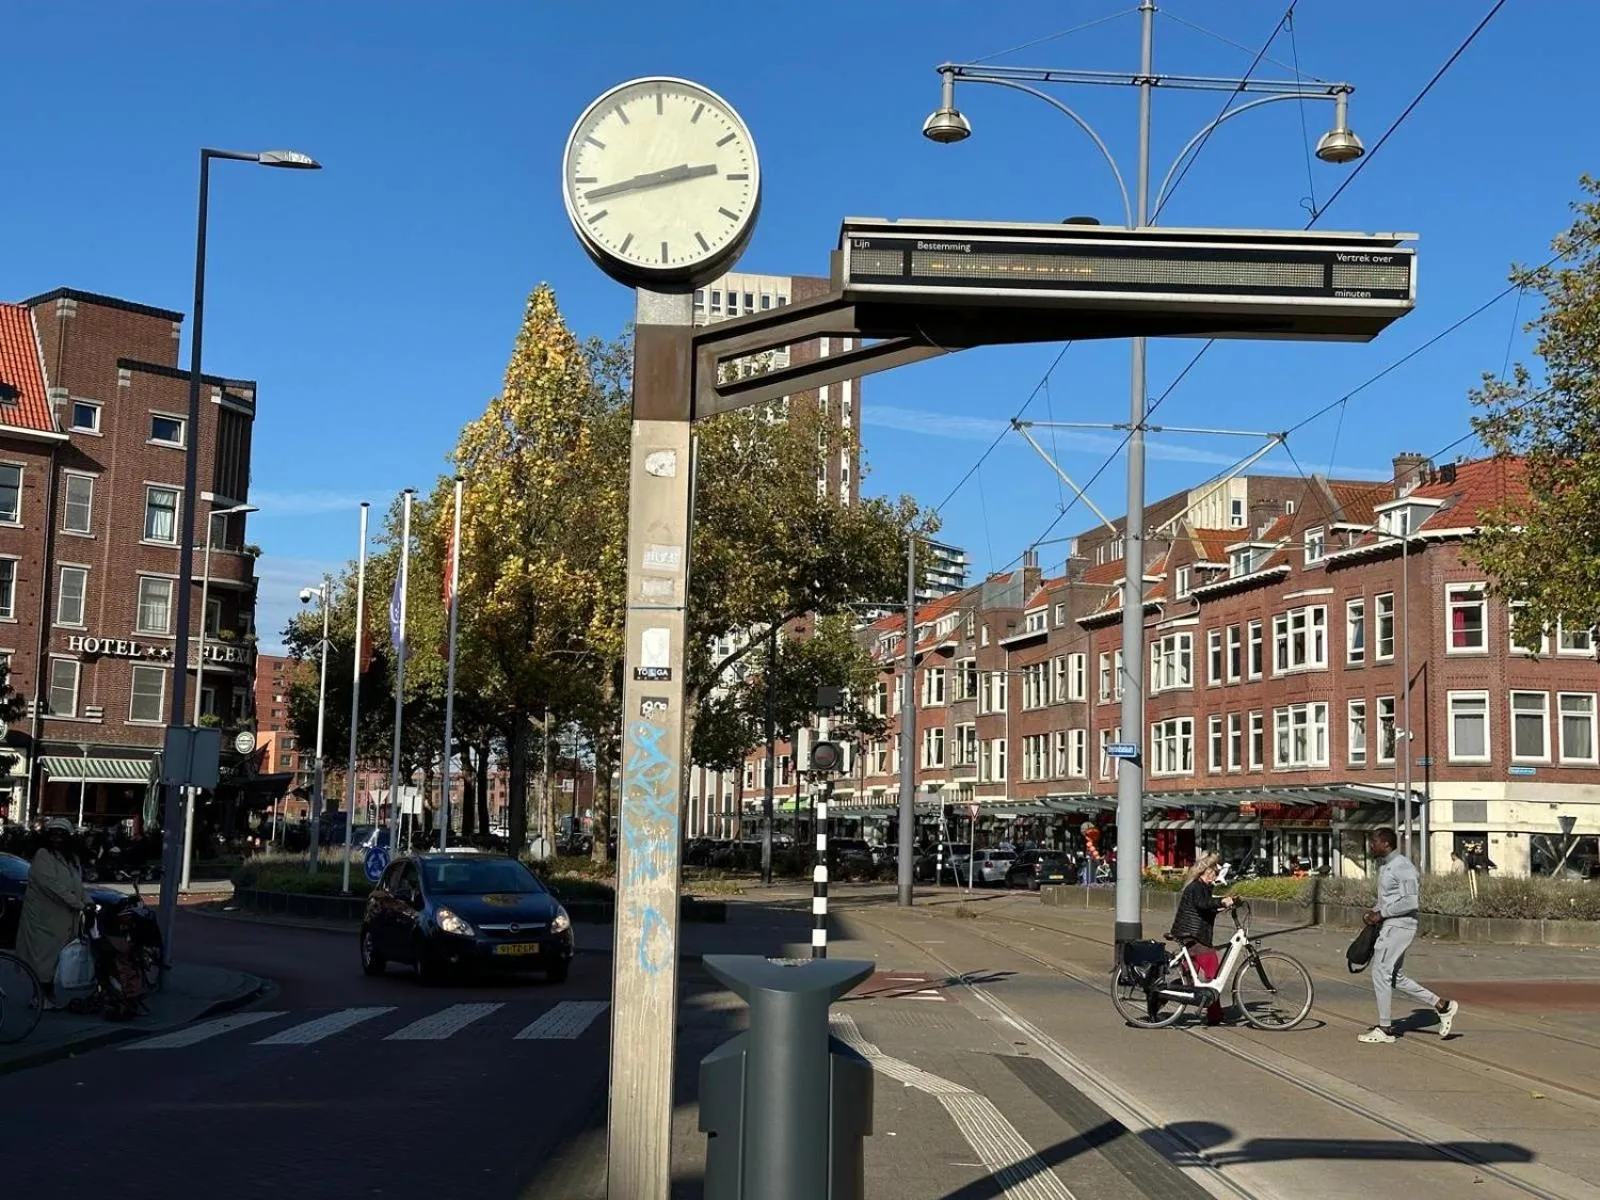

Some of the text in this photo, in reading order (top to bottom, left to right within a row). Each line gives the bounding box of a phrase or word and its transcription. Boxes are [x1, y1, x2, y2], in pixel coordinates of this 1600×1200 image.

[854, 240, 870, 249] Lijn
[917, 241, 971, 252] Bestemming
[1336, 253, 1393, 263] Vertrek over
[1334, 289, 1371, 298] minuten
[68, 635, 141, 656] HOTEL
